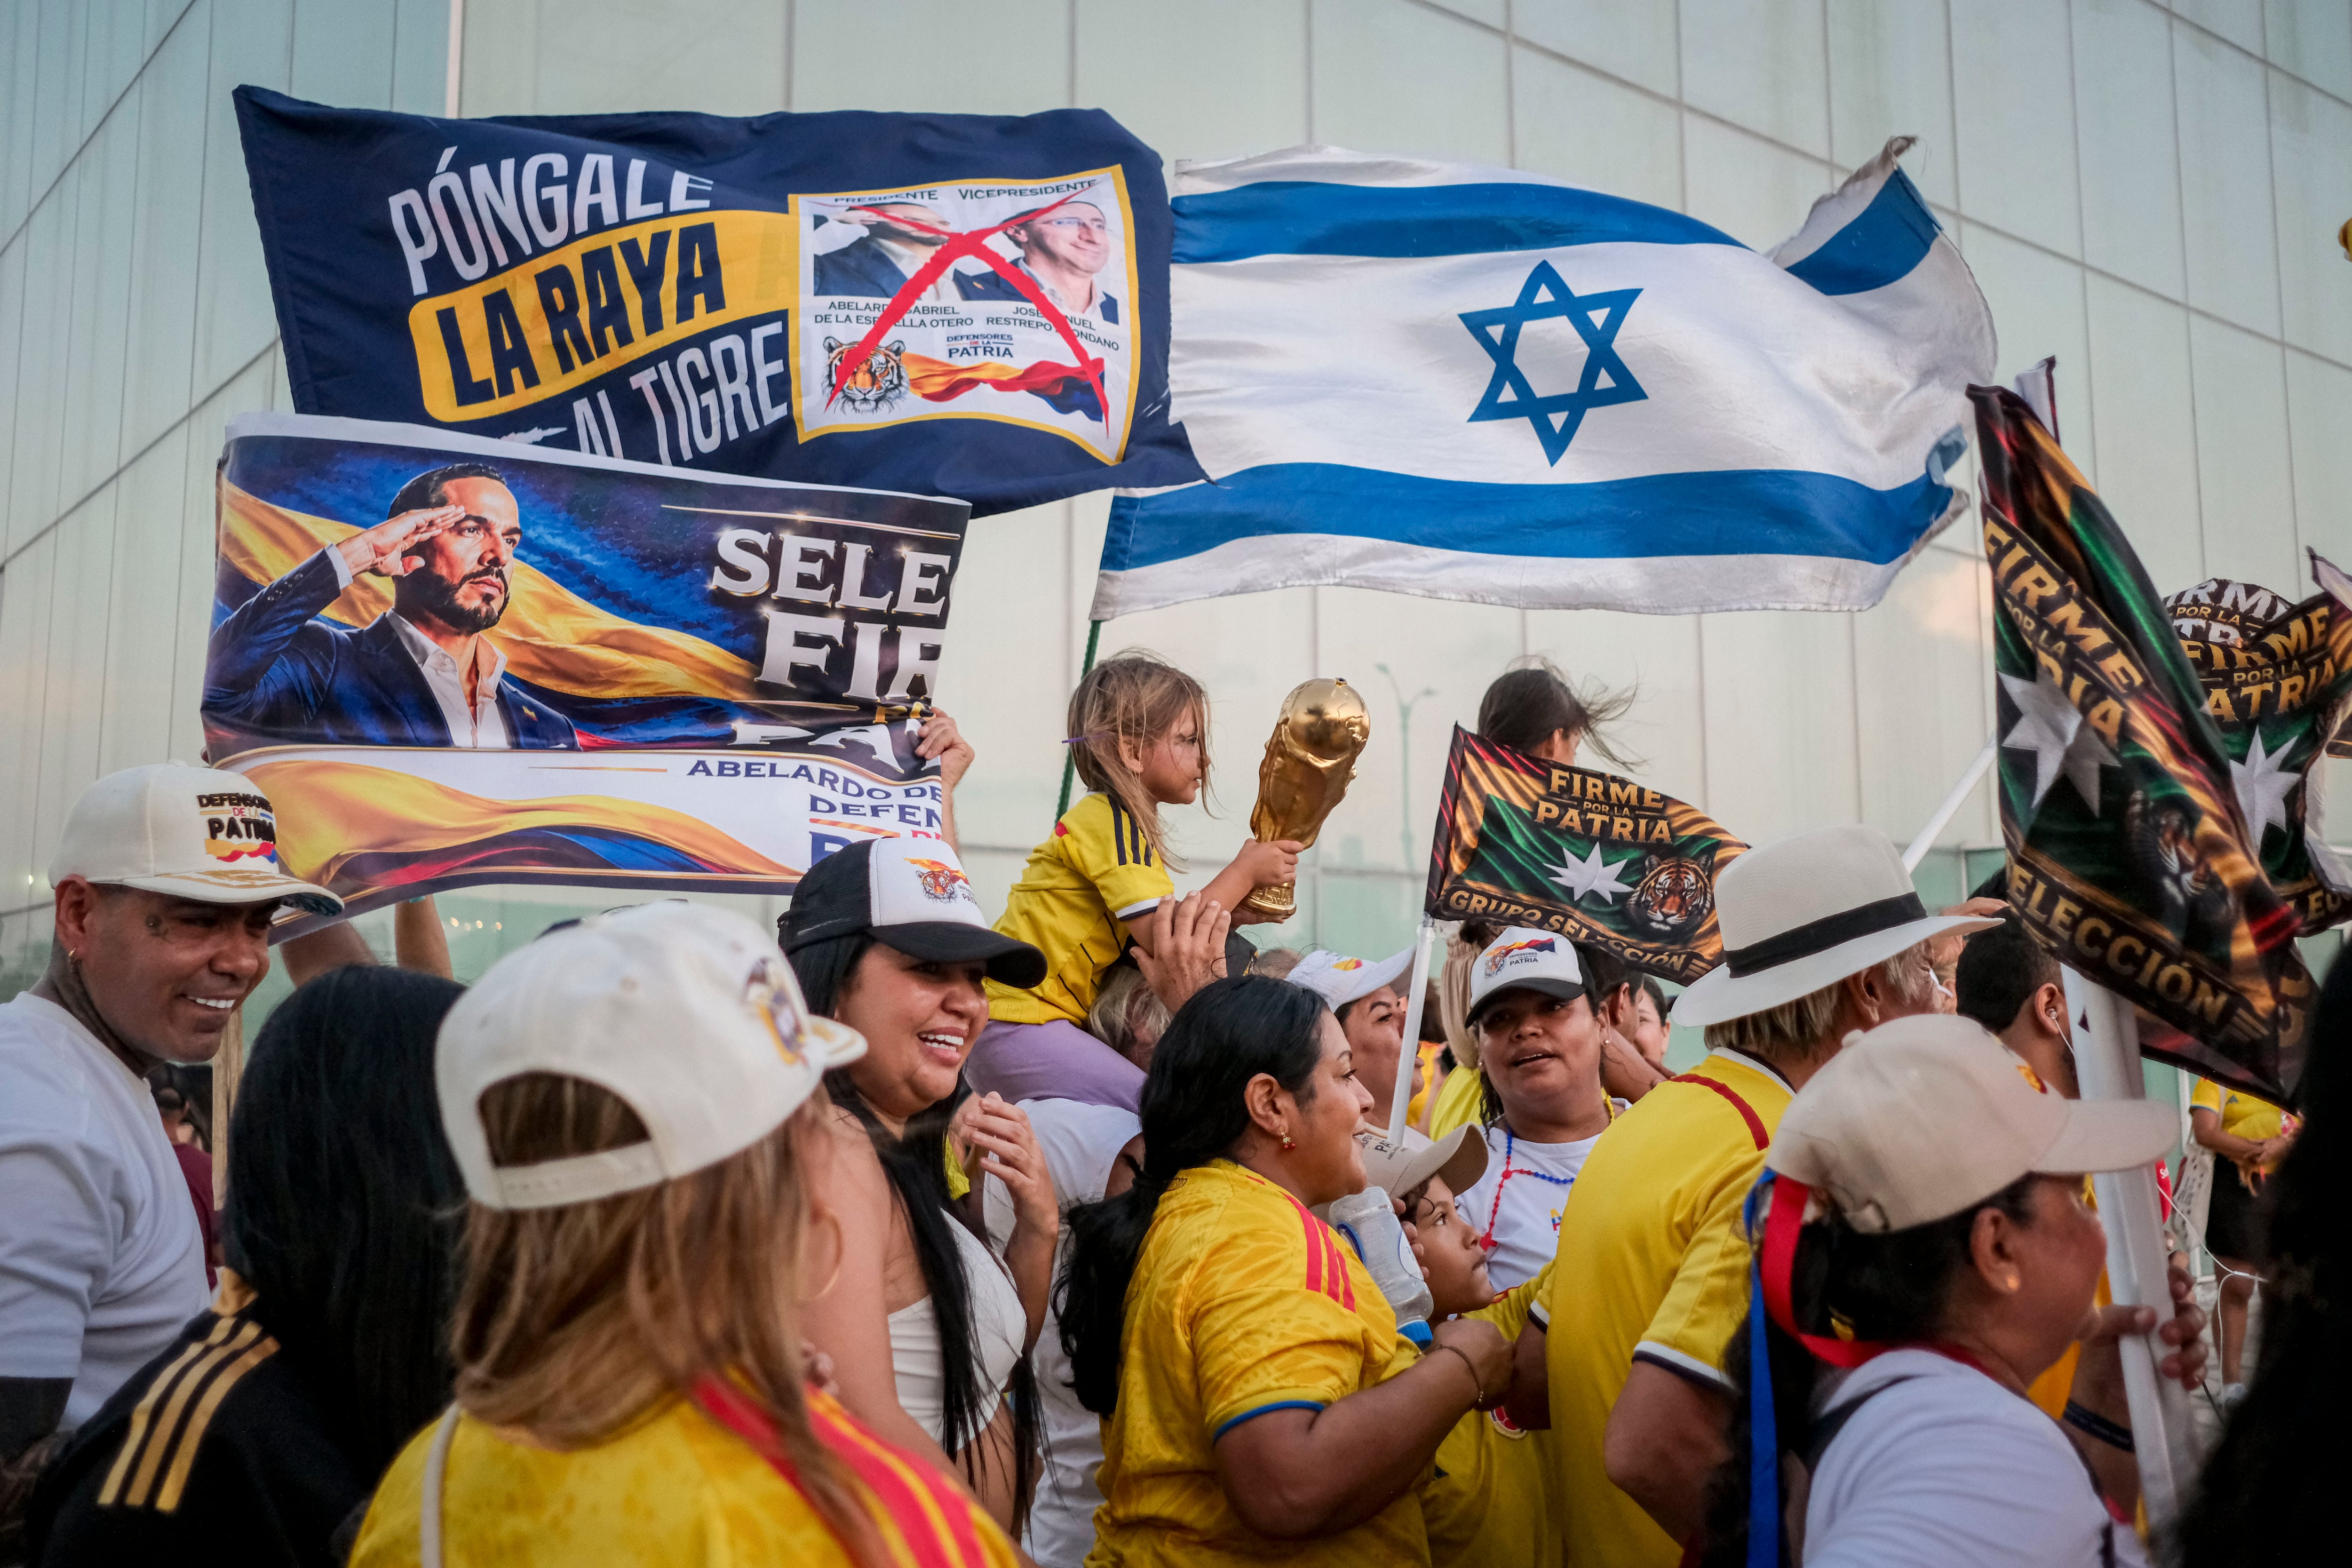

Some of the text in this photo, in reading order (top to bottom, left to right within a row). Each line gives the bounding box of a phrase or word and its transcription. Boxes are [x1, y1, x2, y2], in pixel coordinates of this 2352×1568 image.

[958, 179, 1097, 200] VICEPRESIDENTE
[388, 145, 714, 296] PÓNGALE
[435, 222, 726, 407] LA RAYA
[828, 301, 889, 312] ABELAR
[815, 314, 832, 323] DE
[835, 314, 852, 324] LA
[930, 318, 974, 327] OTERO
[1065, 315, 1096, 331] NUEL
[947, 334, 1013, 342] DEFENSORES
[986, 317, 1119, 351] RESTREPO ONDANO
[948, 346, 1014, 358] PATRIA
[629, 320, 788, 466] TIGRE
[2176, 606, 2241, 626] POR LA
[2038, 630, 2067, 659] LA
[2233, 668, 2274, 685] POR
[687, 760, 892, 800] ABELARDO
[1549, 768, 1664, 809] FIRME
[232, 807, 260, 819] DE LA
[1583, 801, 1630, 816] POR LA
[1534, 800, 1673, 844] PATRIA
[1449, 890, 1687, 972] GRUPO SELCCIÓN
[2007, 865, 2228, 1024] ELECCIÓN
[1510, 957, 1538, 966] PATRIA
